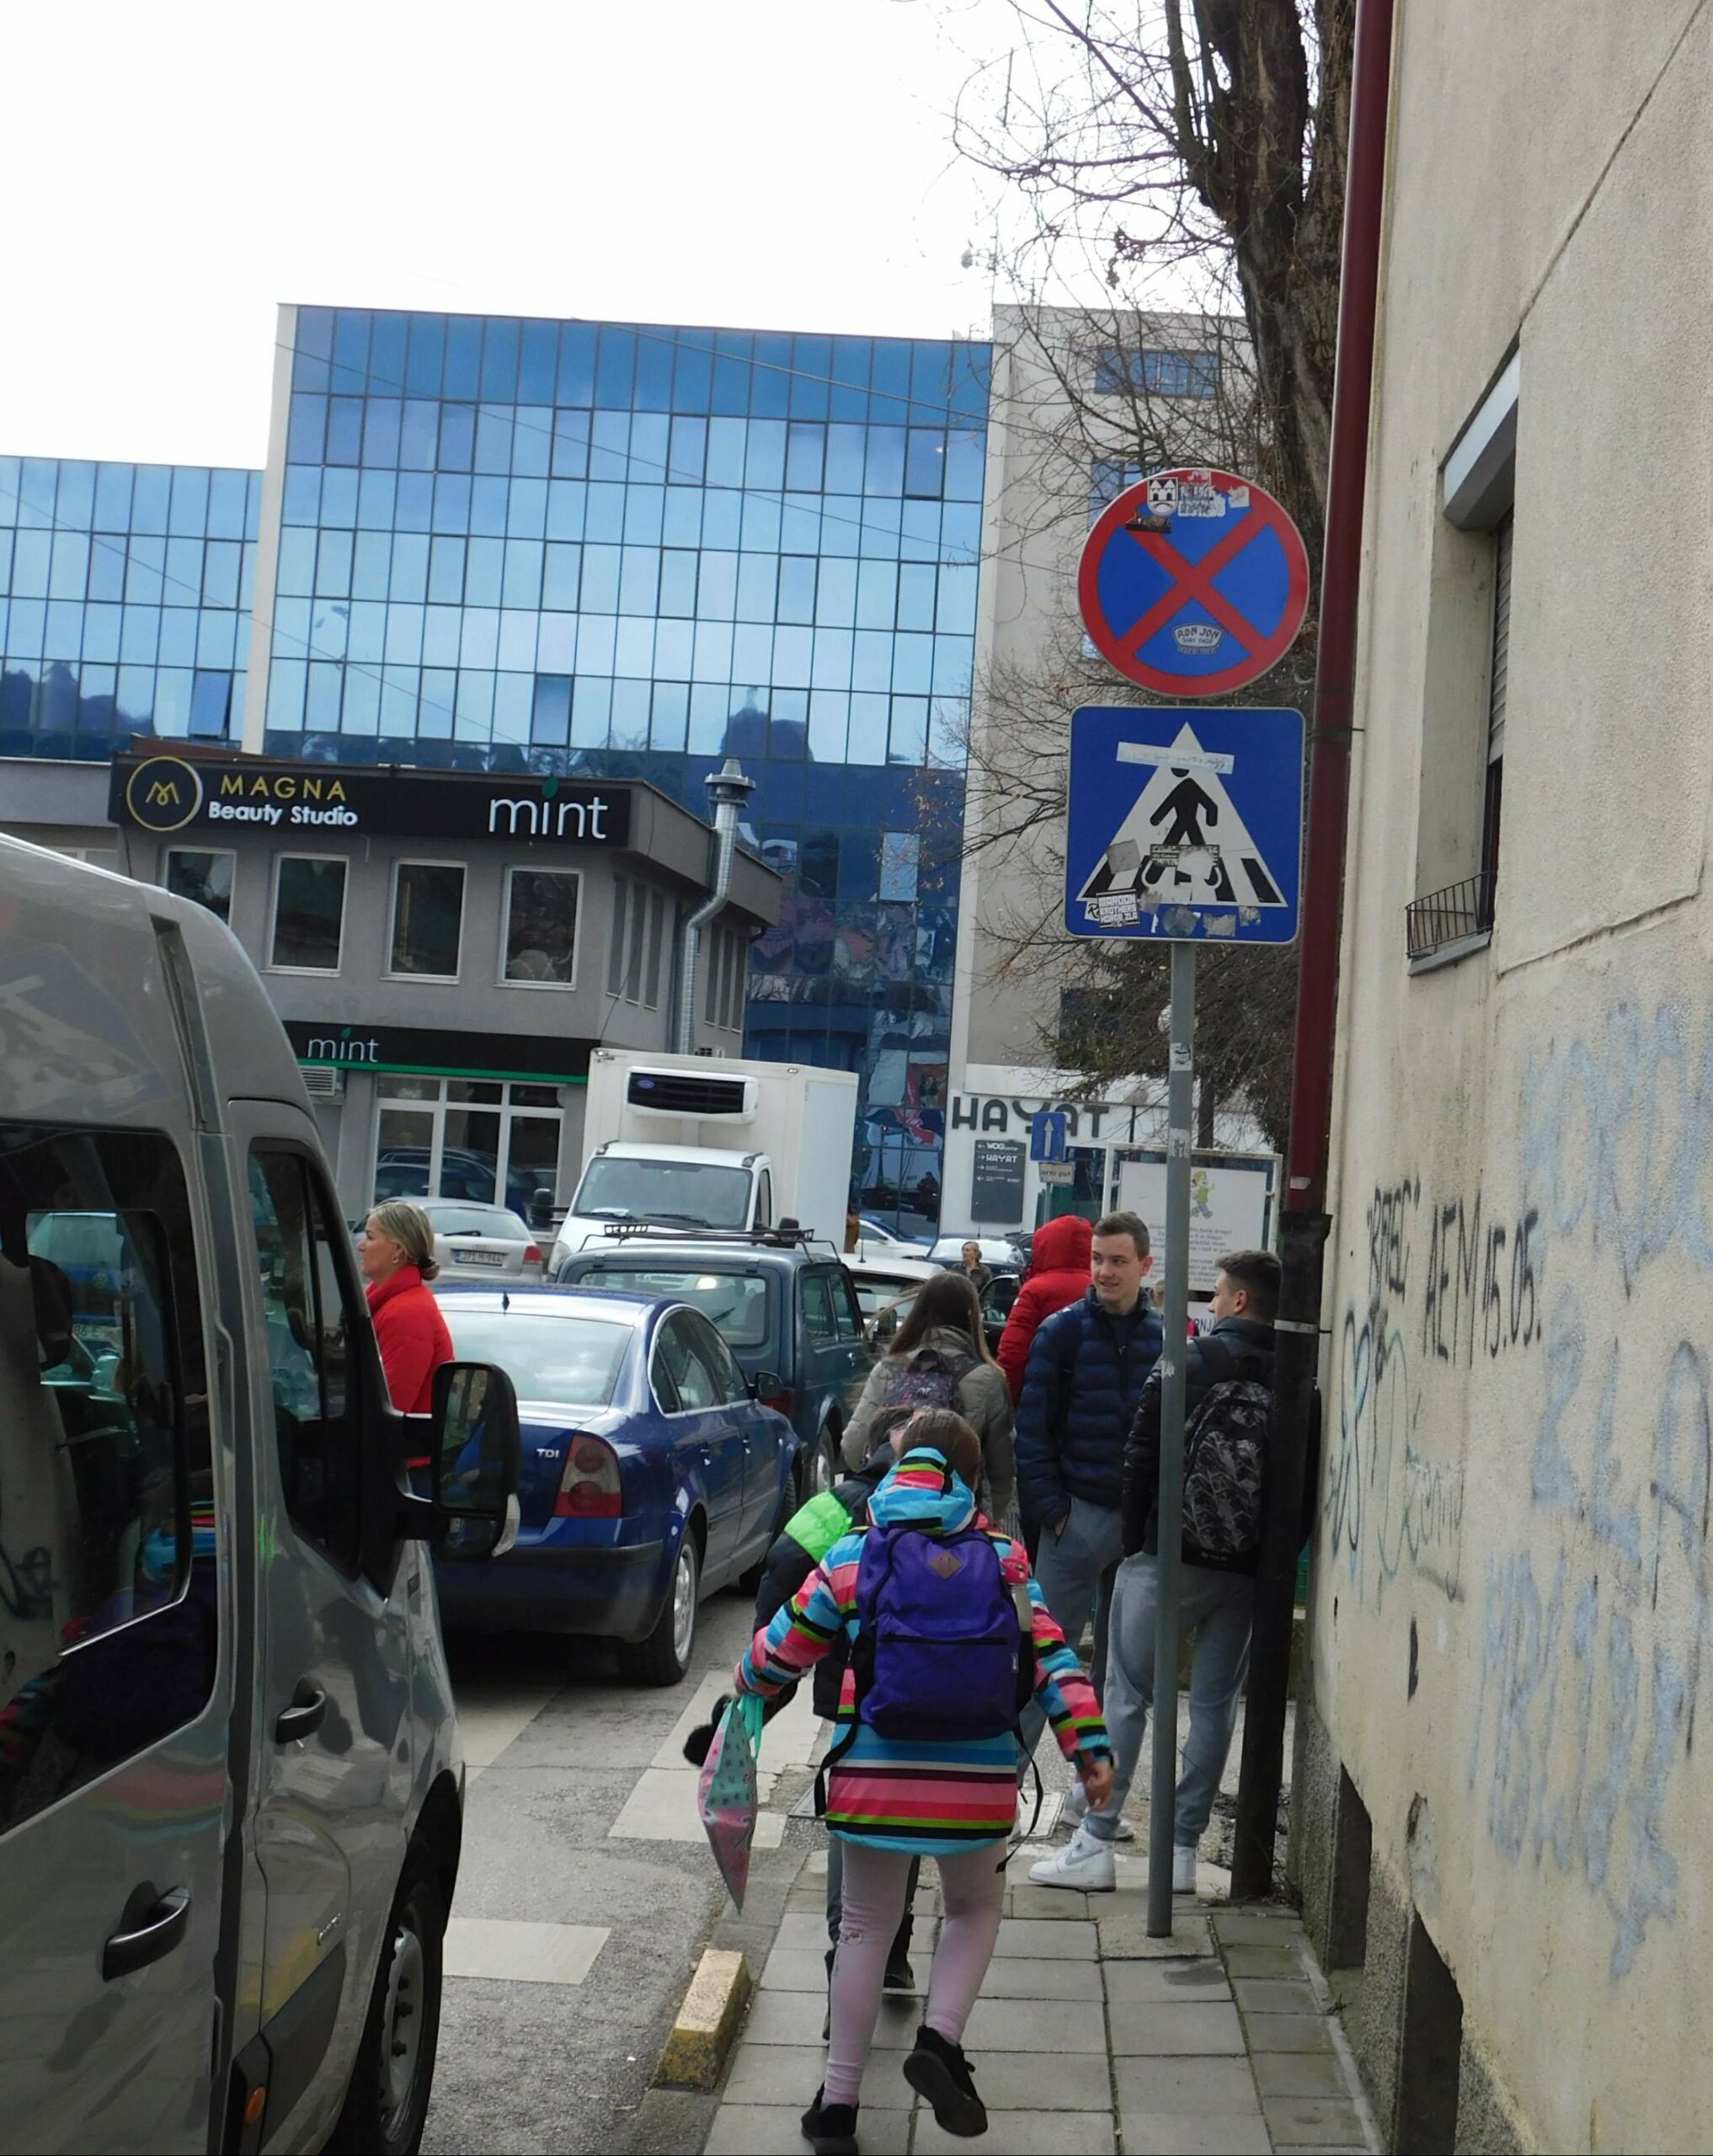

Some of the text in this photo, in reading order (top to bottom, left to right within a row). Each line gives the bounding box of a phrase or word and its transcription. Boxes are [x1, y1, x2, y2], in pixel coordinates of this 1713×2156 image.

[1177, 626, 1220, 639] RON JON
[220, 774, 347, 802] MAGNA
[208, 801, 358, 826] Beauty Studio
[488, 796, 609, 840] mint
[307, 1037, 379, 1063] mint
[952, 1097, 1110, 1138] HAYAT
[986, 1155, 1017, 1163] HAYAT
[536, 1448, 560, 1459] TDI
